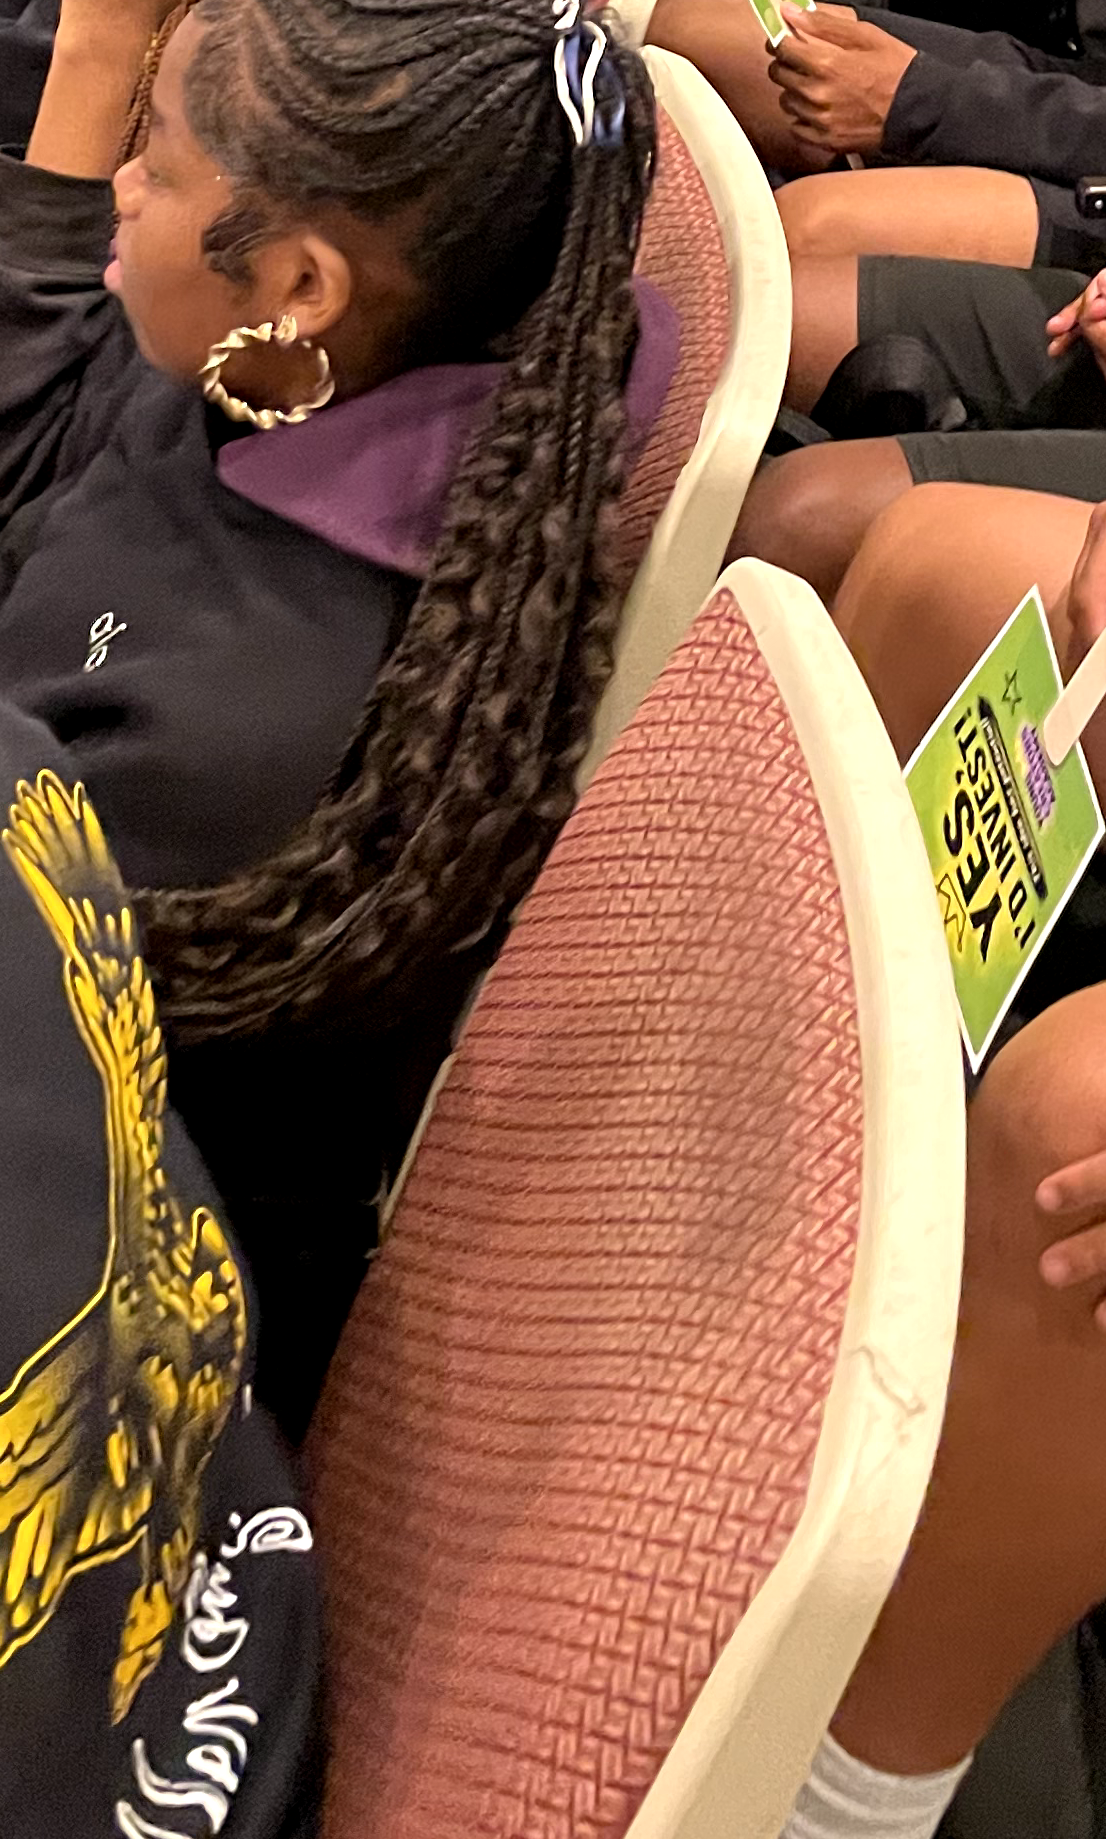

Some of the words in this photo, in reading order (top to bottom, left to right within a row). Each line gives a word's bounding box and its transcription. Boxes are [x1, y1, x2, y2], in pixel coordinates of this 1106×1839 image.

[943, 769, 1003, 963] YES,
[953, 707, 1017, 884] INVEST!
[1009, 880, 1036, 950] I'D
